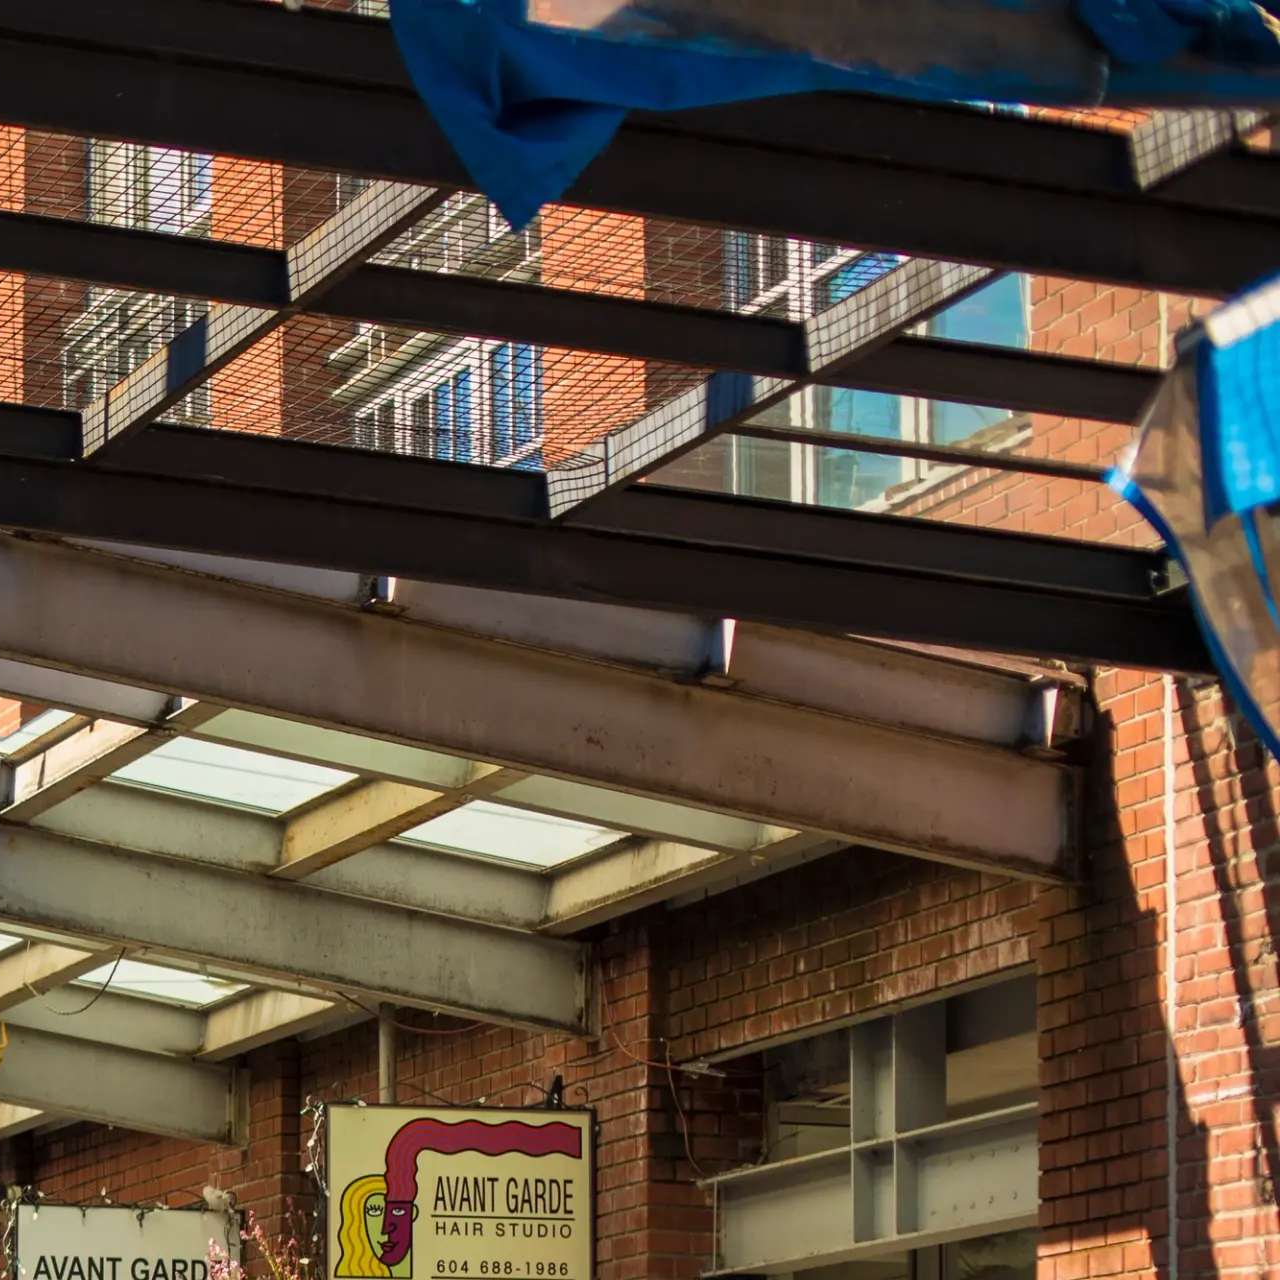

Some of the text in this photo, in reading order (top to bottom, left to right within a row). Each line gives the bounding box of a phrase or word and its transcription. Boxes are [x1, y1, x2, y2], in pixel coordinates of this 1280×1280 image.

[434, 1176, 573, 1214] AVANT GARDE
[435, 1221, 572, 1238] HAIR STUDIO
[436, 1259, 568, 1276] 604 688-1986
